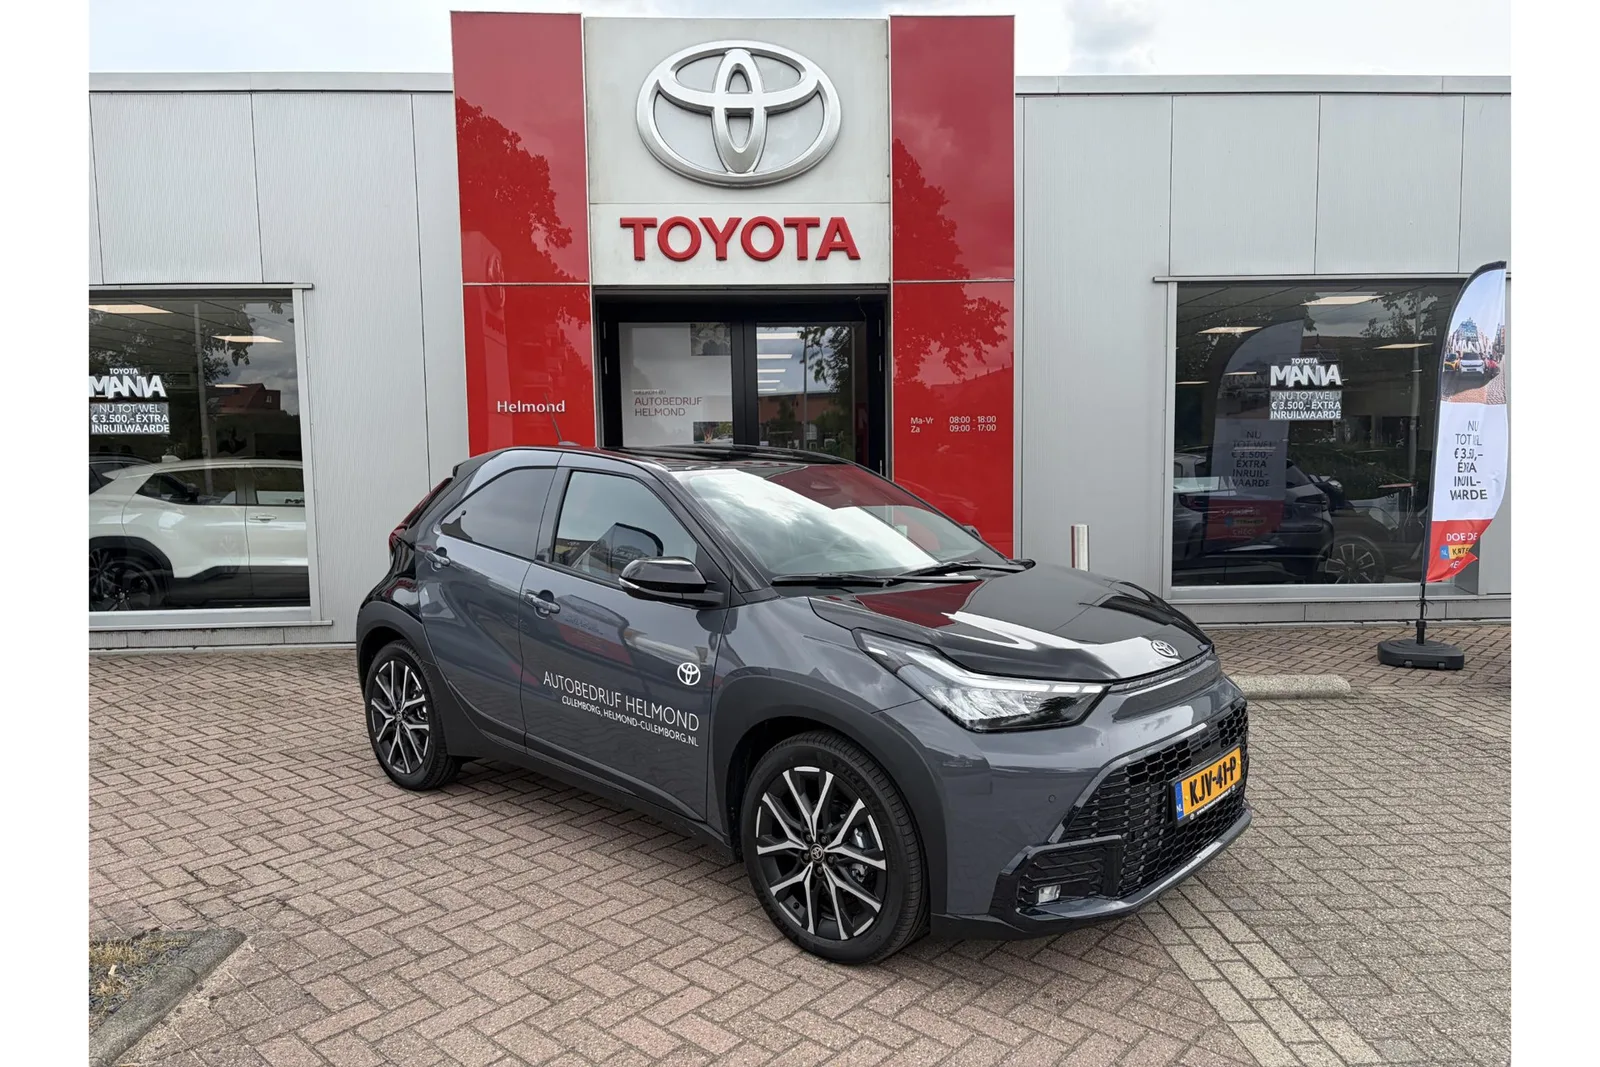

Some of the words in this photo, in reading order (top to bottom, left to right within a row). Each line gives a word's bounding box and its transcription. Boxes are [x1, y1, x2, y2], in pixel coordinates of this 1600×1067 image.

[620, 216, 861, 262] TOYOTA
[1270, 364, 1342, 387] MANIA
[89, 375, 167, 399] MANIA
[1279, 391, 1293, 400] NU
[1296, 391, 1313, 400] TOT
[1315, 391, 1334, 400] WEL
[496, 400, 566, 413] Helmond
[634, 397, 703, 406] AUTOBEDRIJF
[1311, 399, 1341, 410] ÉXTRA
[99, 404, 114, 413] NU
[118, 404, 136, 413] TOT
[140, 404, 161, 413] WEL
[634, 407, 686, 417] HELMOND
[136, 412, 169, 423] ÉXTRA
[949, 416, 971, 424] 08:00
[977, 415, 997, 423] 18:00
[1270, 410, 1341, 419] INRUILWAARDE
[91, 424, 170, 433] INRUILWAARDE
[910, 425, 921, 433] Za
[949, 424, 971, 432] 09:00
[977, 424, 997, 432] 17:00
[1467, 420, 1480, 431] NU
[1246, 431, 1261, 439] NU
[1455, 433, 1472, 445] TOT
[1446, 532, 1466, 542] DOE
[543, 670, 622, 709] AUTOBEDRIJF
[626, 695, 699, 732] HELMOND
[561, 695, 603, 717] CULEMBORG,
[603, 709, 699, 747] HELMOND-CULEMBORG.NL
